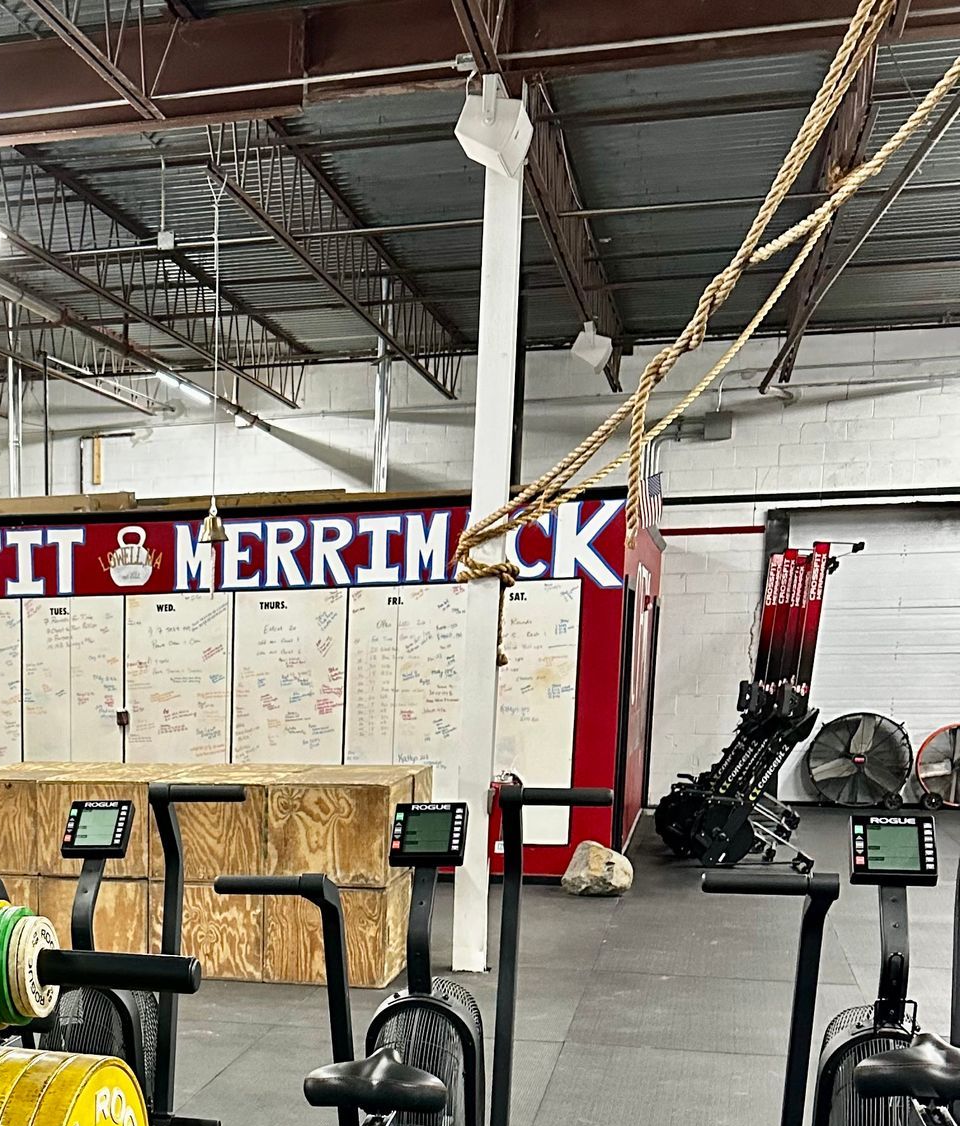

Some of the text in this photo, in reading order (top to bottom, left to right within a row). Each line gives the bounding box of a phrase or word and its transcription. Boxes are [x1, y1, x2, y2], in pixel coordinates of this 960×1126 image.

[174, 499, 626, 590] MERRIMCK
[809, 552, 822, 600] CROSSFIT
[387, 596, 404, 606] FRI.
[509, 592, 527, 602] SAT.
[156, 603, 176, 612] WED.
[259, 600, 288, 610] THURS.
[49, 607, 70, 616] TUES.
[869, 817, 916, 825] ROGUE
